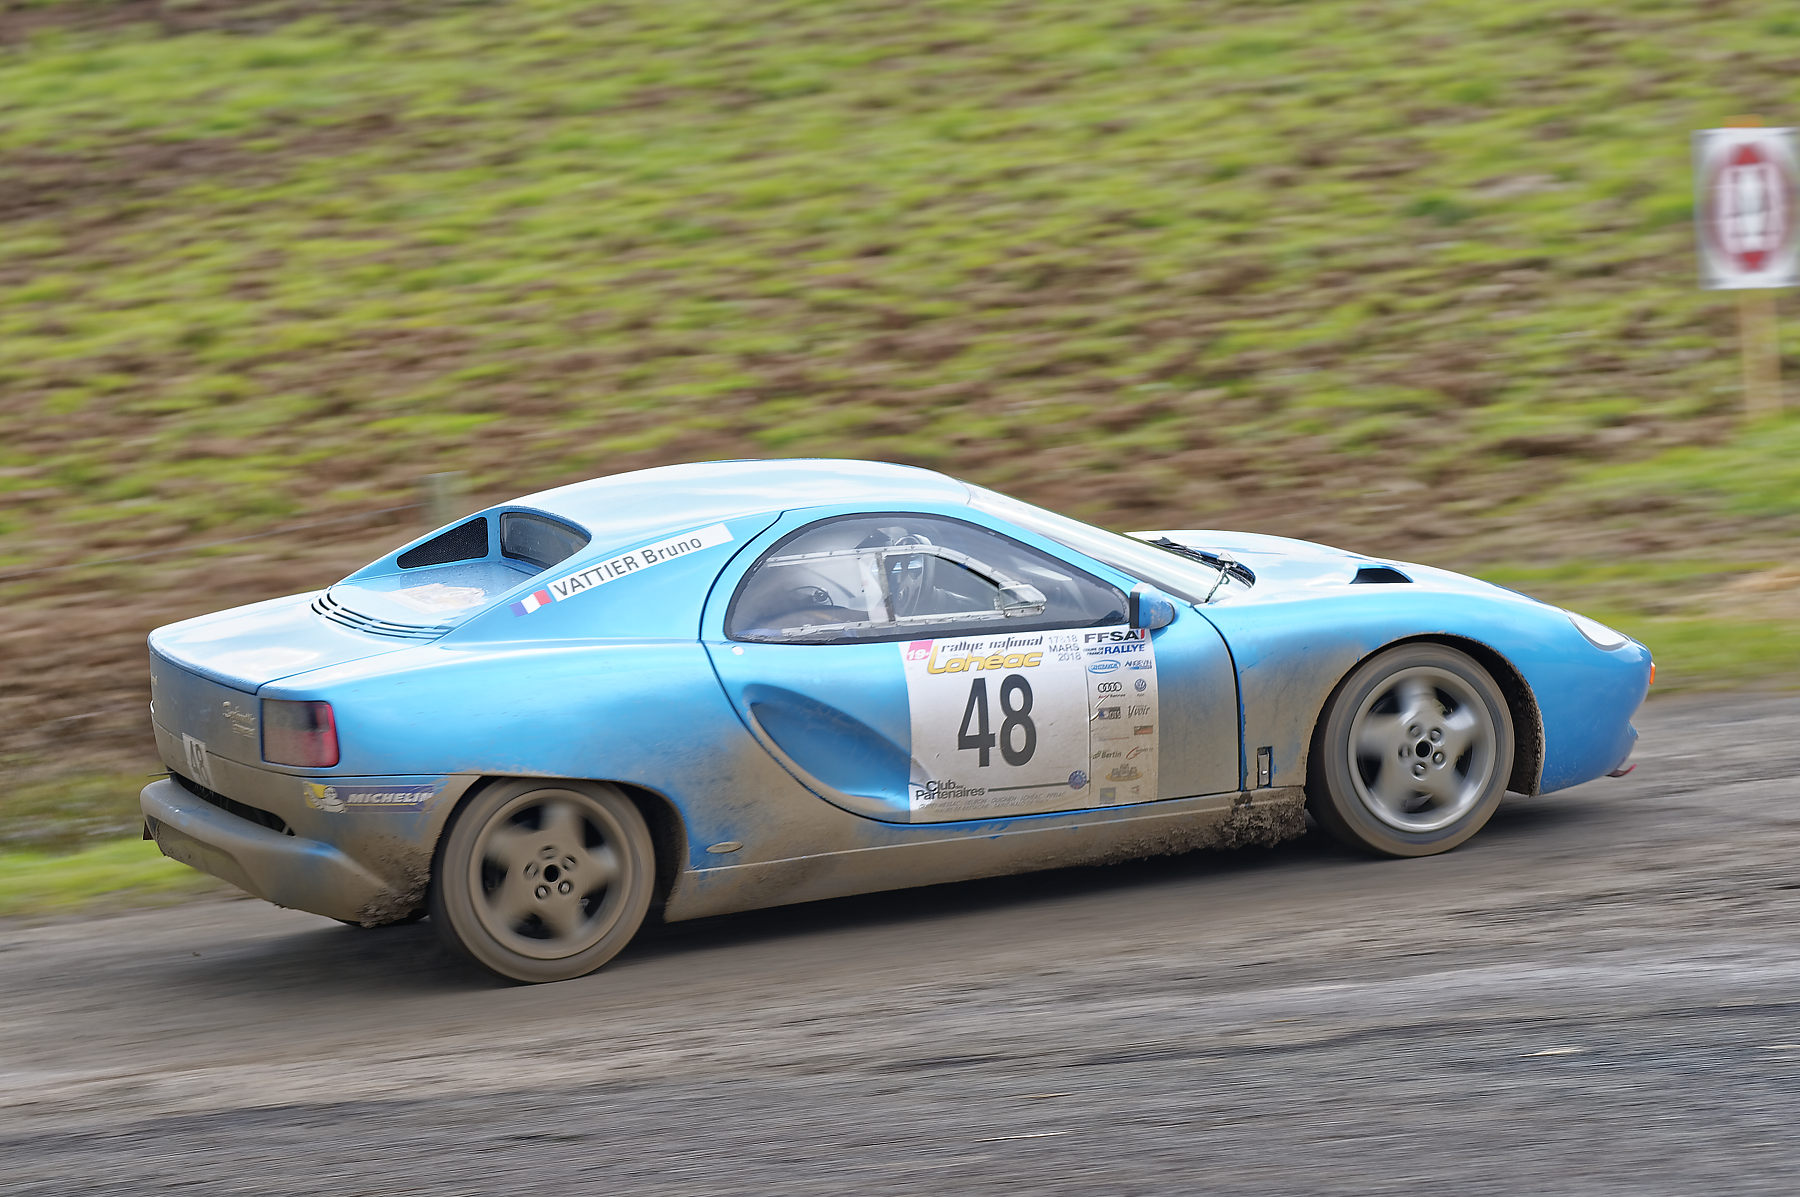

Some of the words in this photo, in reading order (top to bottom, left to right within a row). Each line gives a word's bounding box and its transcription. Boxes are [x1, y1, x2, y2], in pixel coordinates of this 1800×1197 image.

[553, 554, 640, 597] VATTIER
[641, 537, 702, 566] Bruno
[941, 640, 984, 653] rallye
[988, 634, 1043, 650] national
[1084, 630, 1139, 644] FFSA
[1048, 643, 1080, 653] MARS
[1104, 643, 1145, 655] RALLYE
[927, 645, 1044, 675] Lohéac
[1057, 652, 1082, 662] 2018
[958, 674, 1036, 767] 48
[926, 780, 956, 792] Club
[347, 791, 434, 803] MICHELIN
[915, 787, 985, 801] Partenaires
